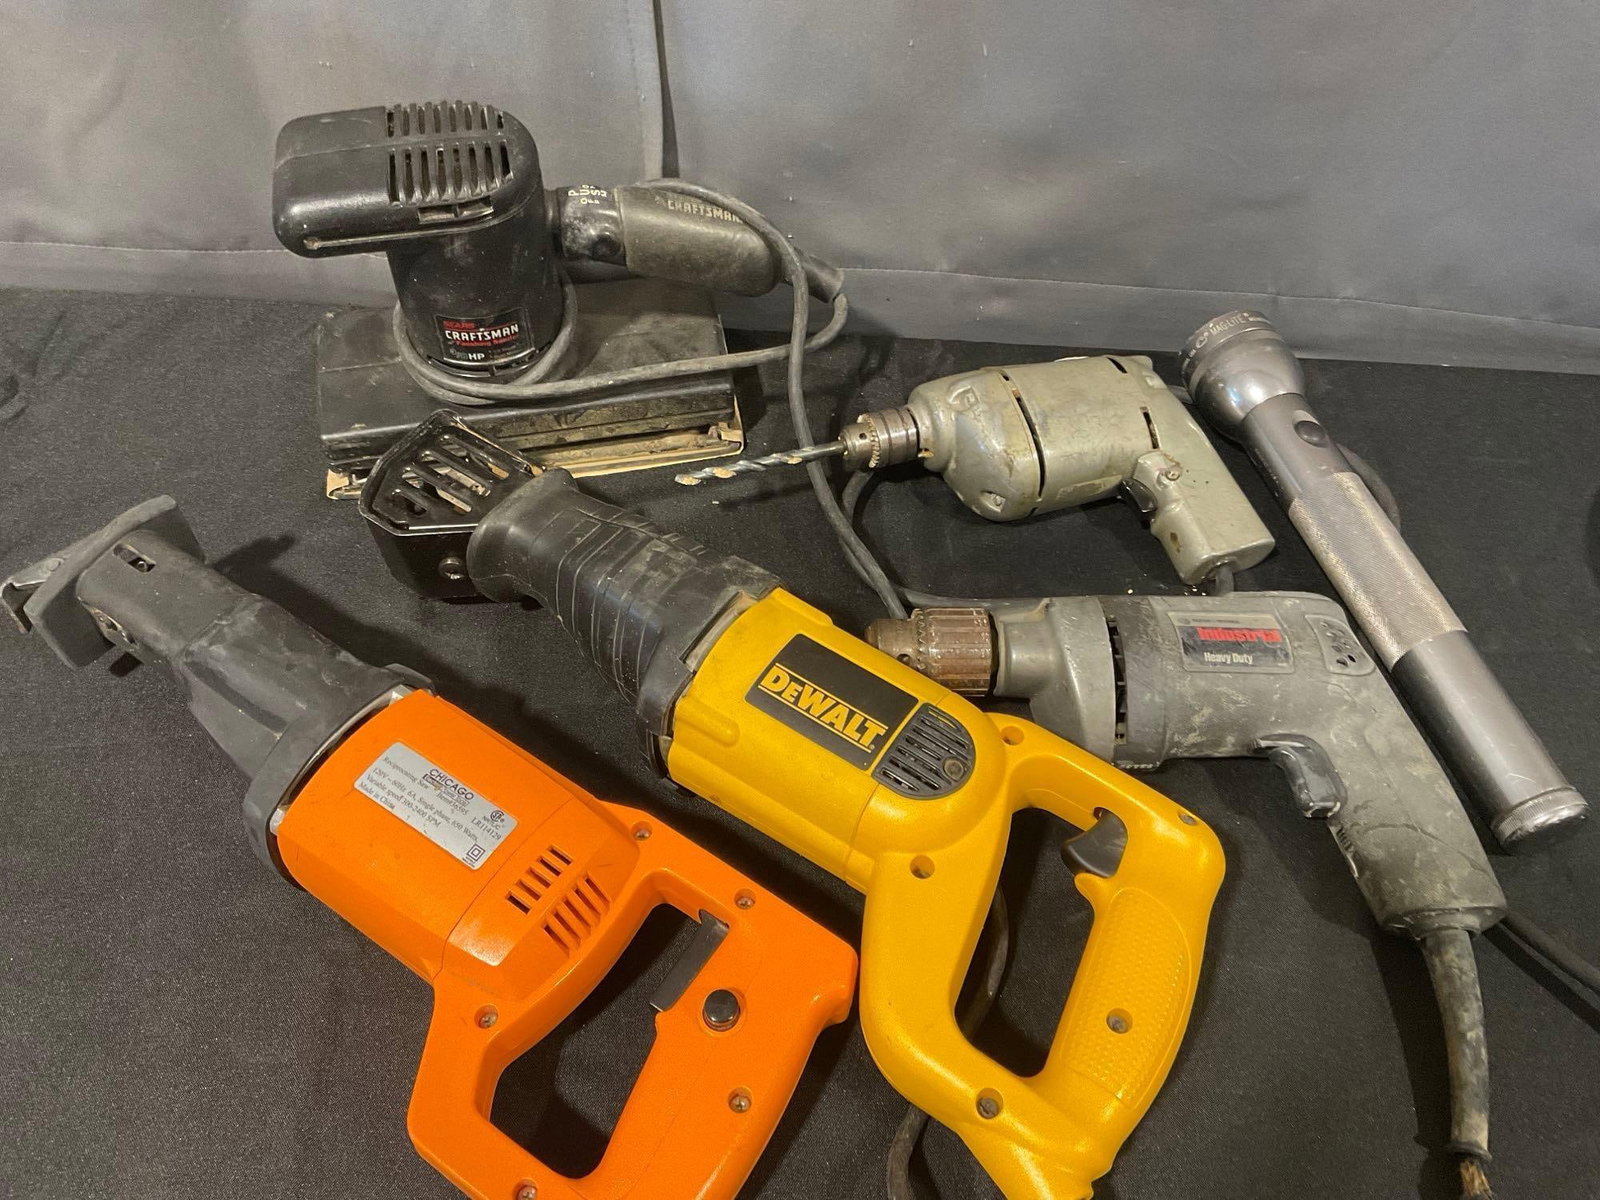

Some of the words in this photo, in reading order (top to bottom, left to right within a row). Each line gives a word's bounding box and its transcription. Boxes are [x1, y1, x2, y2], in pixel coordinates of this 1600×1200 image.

[445, 323, 519, 341] CRAFTSMAN
[468, 352, 485, 361] HP
[1203, 652, 1232, 664] Heavy
[1232, 653, 1253, 665] Duty
[384, 757, 418, 783] Reciprocating
[417, 779, 429, 789] Saw
[430, 768, 474, 800] CHICAGO
[358, 781, 374, 795] Made
[380, 796, 396, 810] China
[366, 774, 387, 791] Variable
[387, 789, 404, 801] speed
[401, 798, 427, 817] 300-2400
[426, 815, 441, 828] SPM
[417, 797, 435, 812] Single
[471, 817, 502, 840] LR114129
